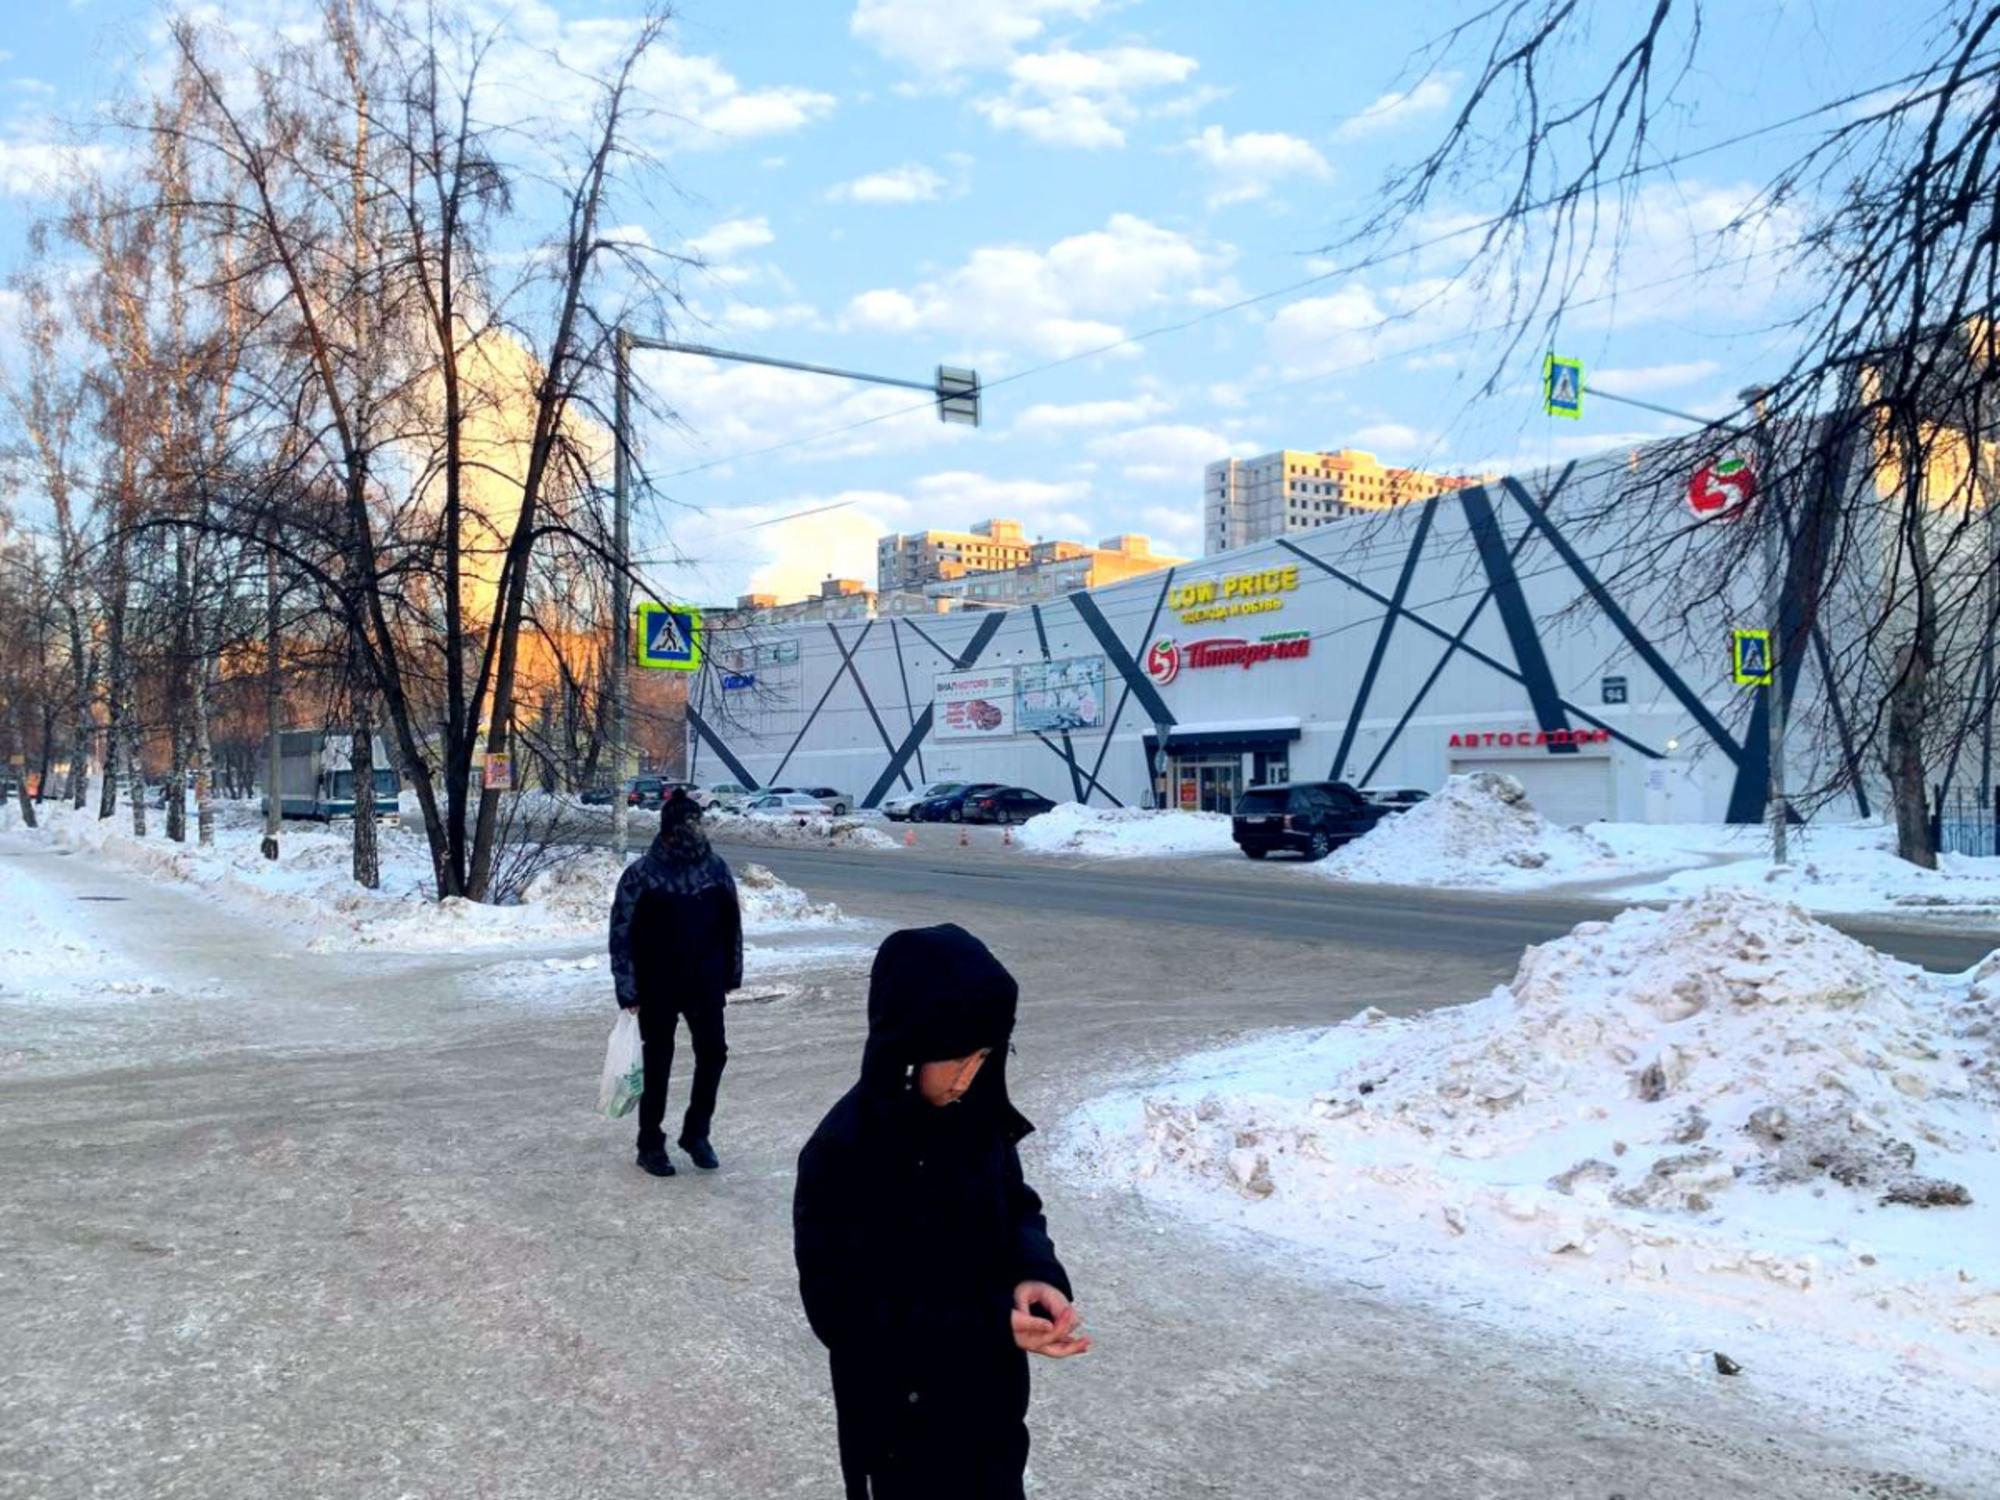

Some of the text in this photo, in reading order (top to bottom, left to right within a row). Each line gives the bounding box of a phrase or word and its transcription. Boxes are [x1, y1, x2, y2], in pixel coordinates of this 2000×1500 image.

[1168, 565, 1299, 610] LOW PRICE
[1241, 598, 1283, 615] ОБУВЬ
[1606, 688, 1623, 702] 94
[1449, 729, 1611, 748] АВТОСАЛОН
